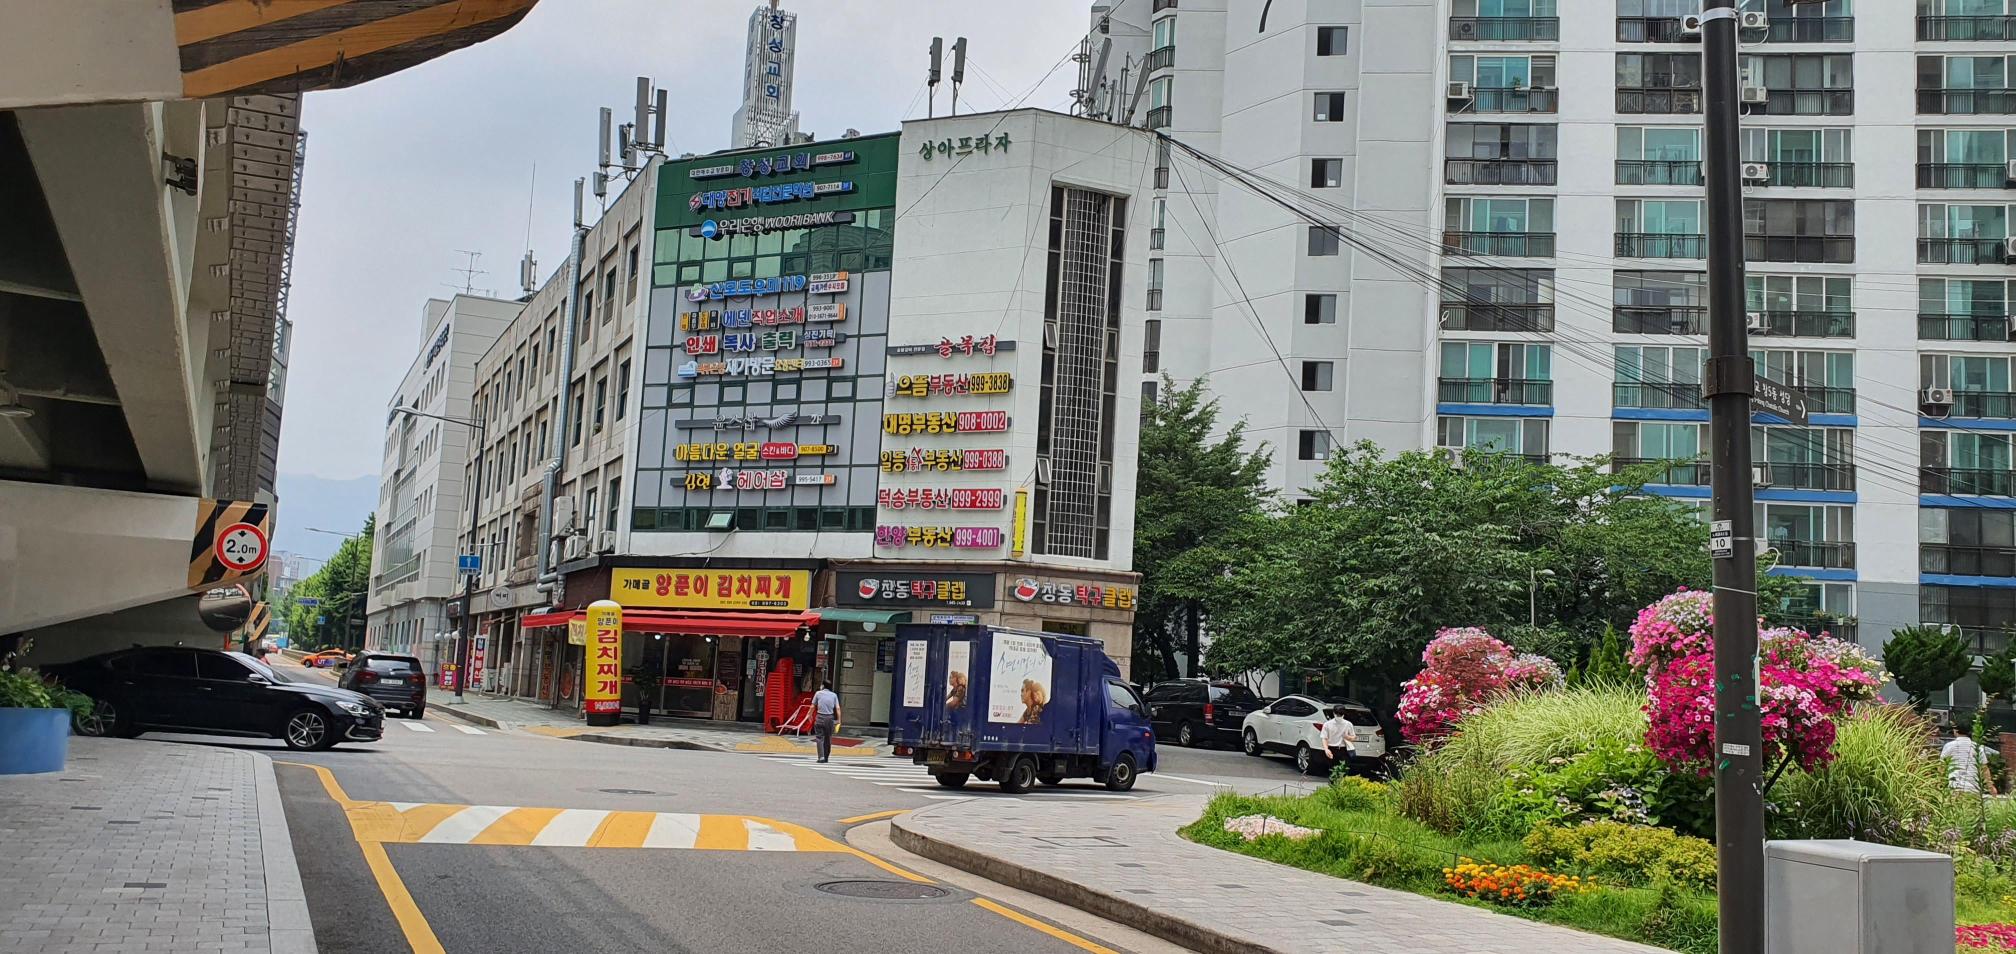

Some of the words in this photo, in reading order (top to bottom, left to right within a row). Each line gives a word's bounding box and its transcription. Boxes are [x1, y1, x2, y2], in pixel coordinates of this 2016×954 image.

[919, 132, 1013, 160] 상아프라자
[719, 216, 764, 236] 우리은행
[765, 213, 803, 231] WOORI
[803, 211, 834, 226] BANK
[685, 335, 718, 355] 인쇄
[723, 332, 756, 351] 복사
[761, 330, 796, 351] 출력
[725, 357, 775, 376] 재가방문
[970, 374, 1008, 392] 999-3838
[883, 411, 956, 435] 대명부동산
[958, 413, 1005, 431] 908-0002
[675, 443, 729, 461] 아름다운
[732, 442, 761, 461] 얼굴
[880, 450, 906, 472] 일등
[923, 449, 963, 471] 부동산
[964, 450, 1003, 468] 999-0388
[684, 473, 711, 491] 김현
[737, 469, 787, 490] 헤어샵
[878, 488, 950, 510] 덕송부동산
[952, 490, 1001, 508] 999-2999
[226, 538, 257, 554] 2.0m
[876, 525, 953, 549] 한양부동산
[956, 529, 998, 546] 999-4001
[1715, 538, 1726, 548] 10
[623, 578, 650, 590] 가메골
[655, 573, 709, 597] 양푼이
[717, 574, 792, 598] 김치찌개
[881, 579, 966, 600] 창동탁구클럽
[1041, 582, 1133, 609] 창동탁구클럽
[597, 617, 618, 626] 양푼이
[597, 629, 618, 695] 김치찌개
